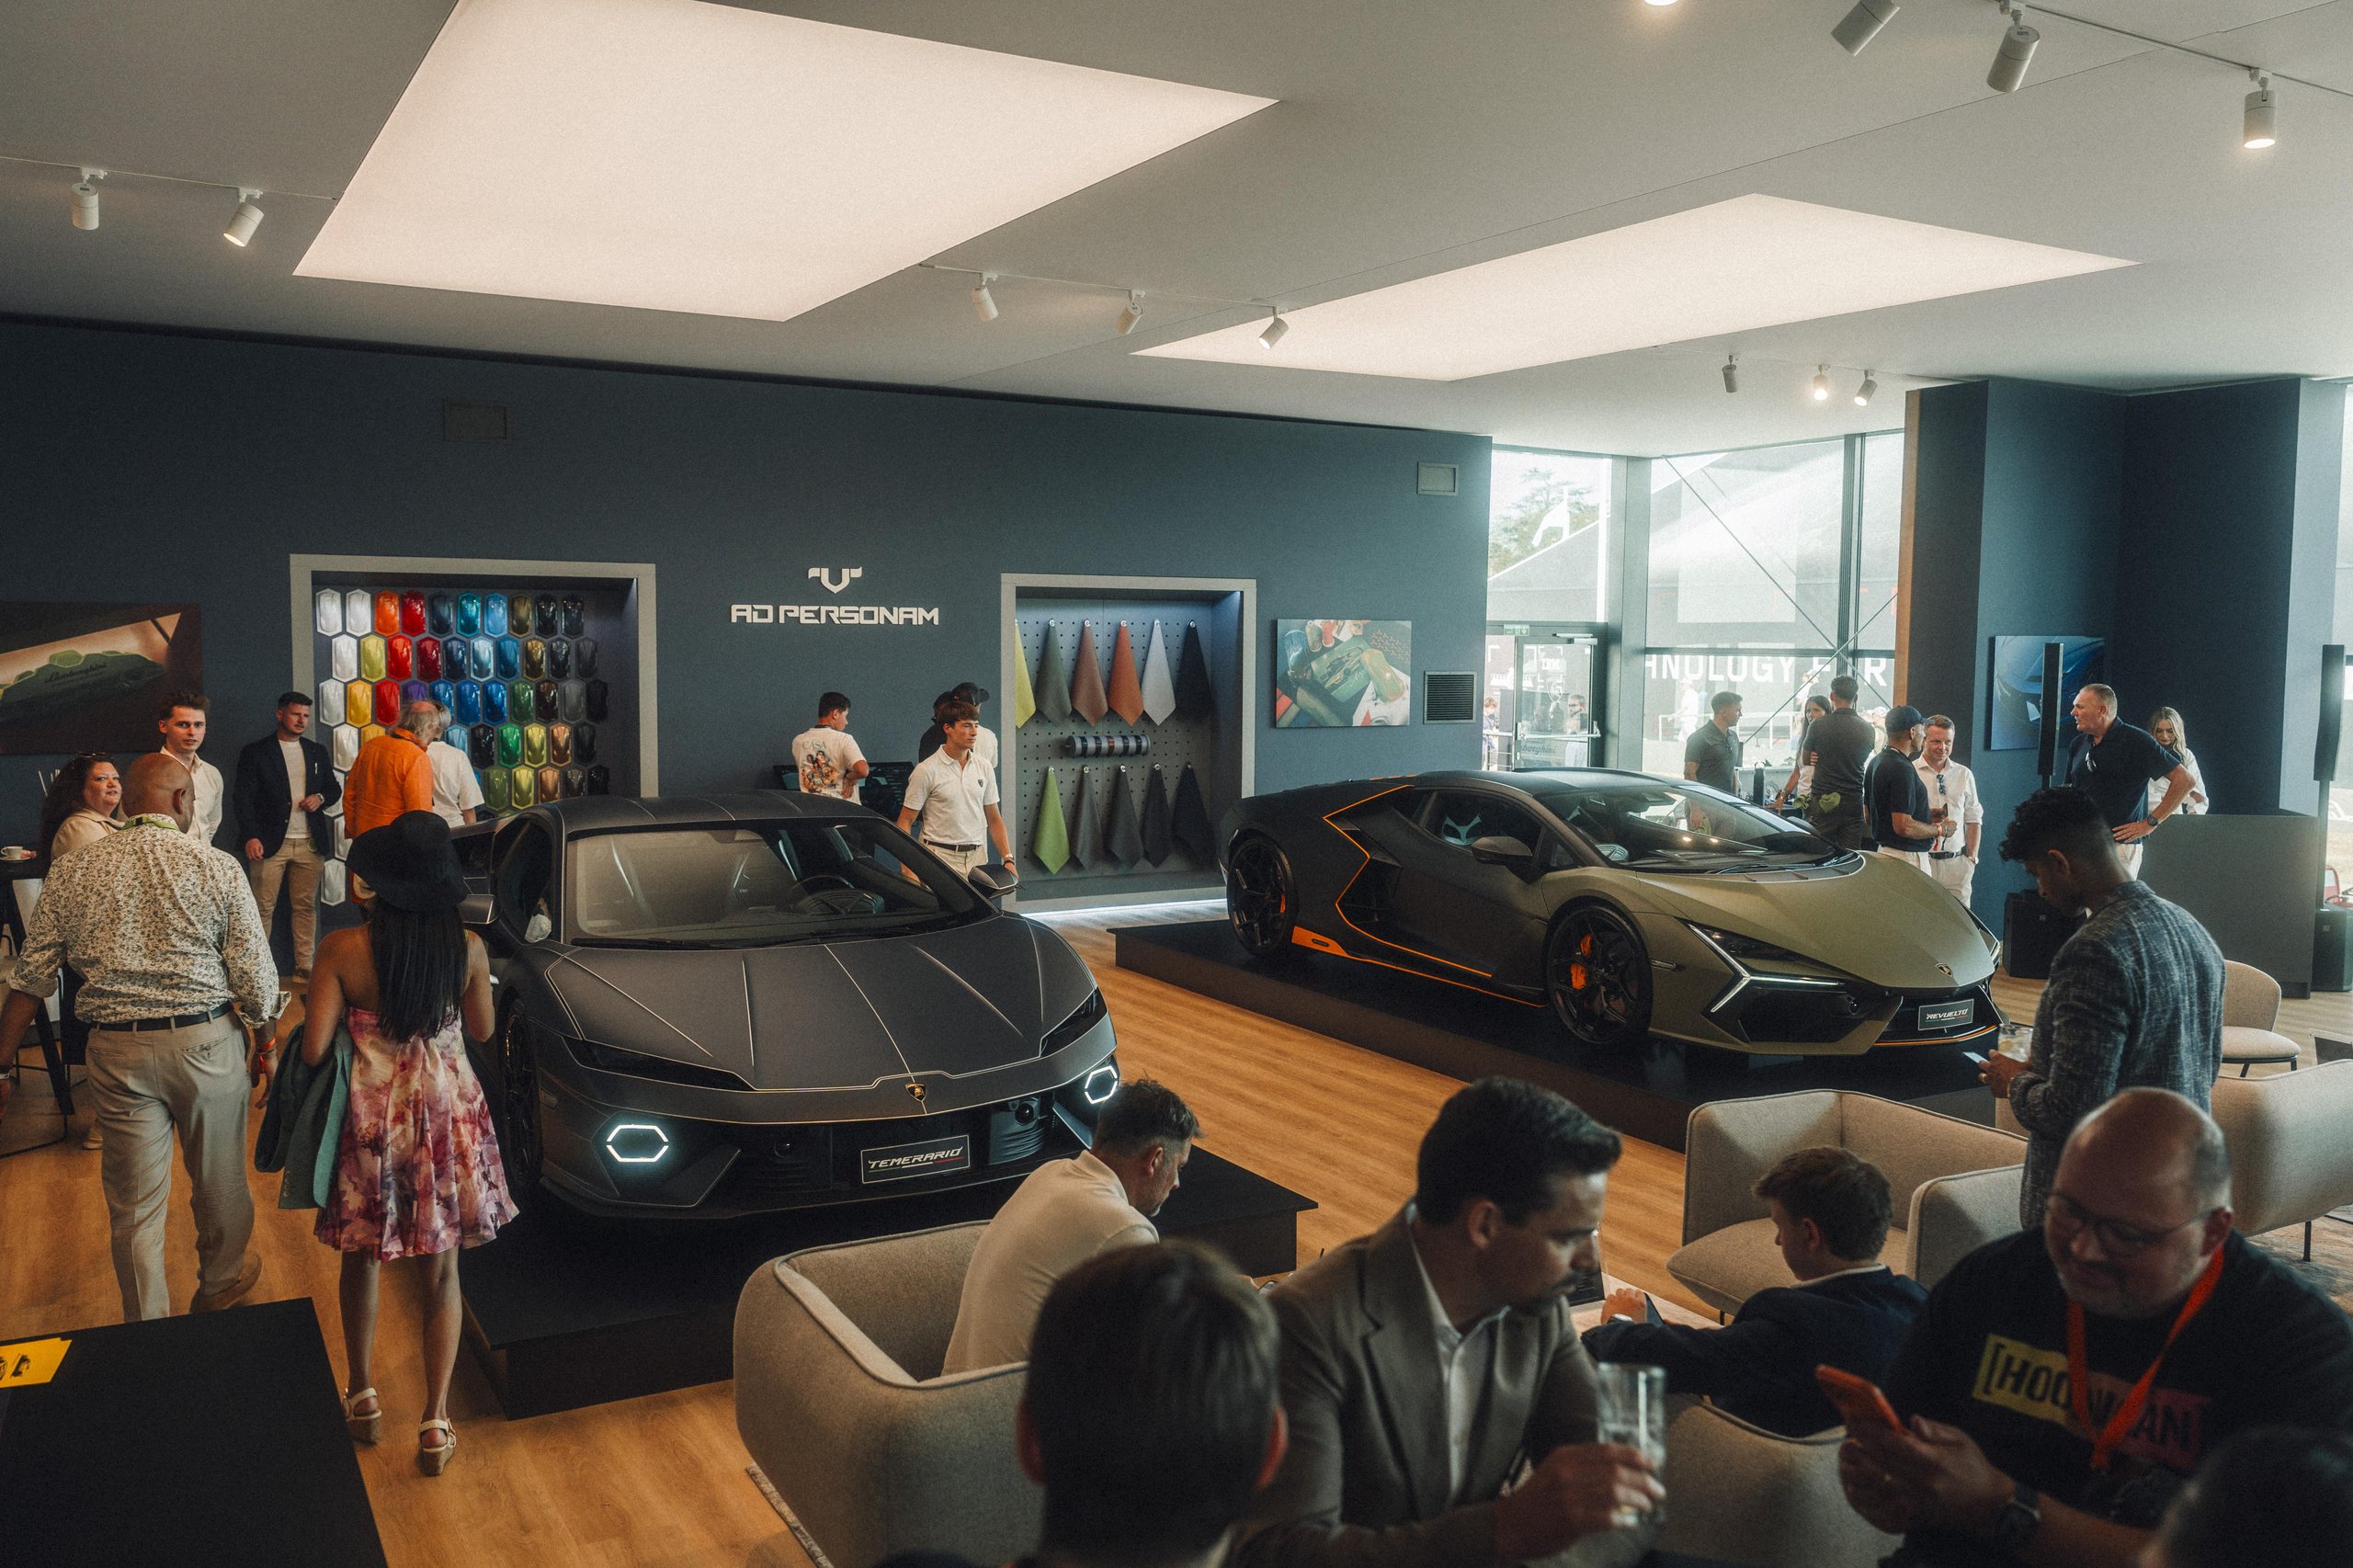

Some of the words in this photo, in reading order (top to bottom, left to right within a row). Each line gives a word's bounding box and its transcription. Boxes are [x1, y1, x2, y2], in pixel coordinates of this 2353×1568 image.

[731, 604, 774, 624] AD
[779, 605, 939, 626] PERSONAM
[1926, 1008, 1968, 1019] REVUELTO
[868, 1146, 963, 1169] TEMERARIO
